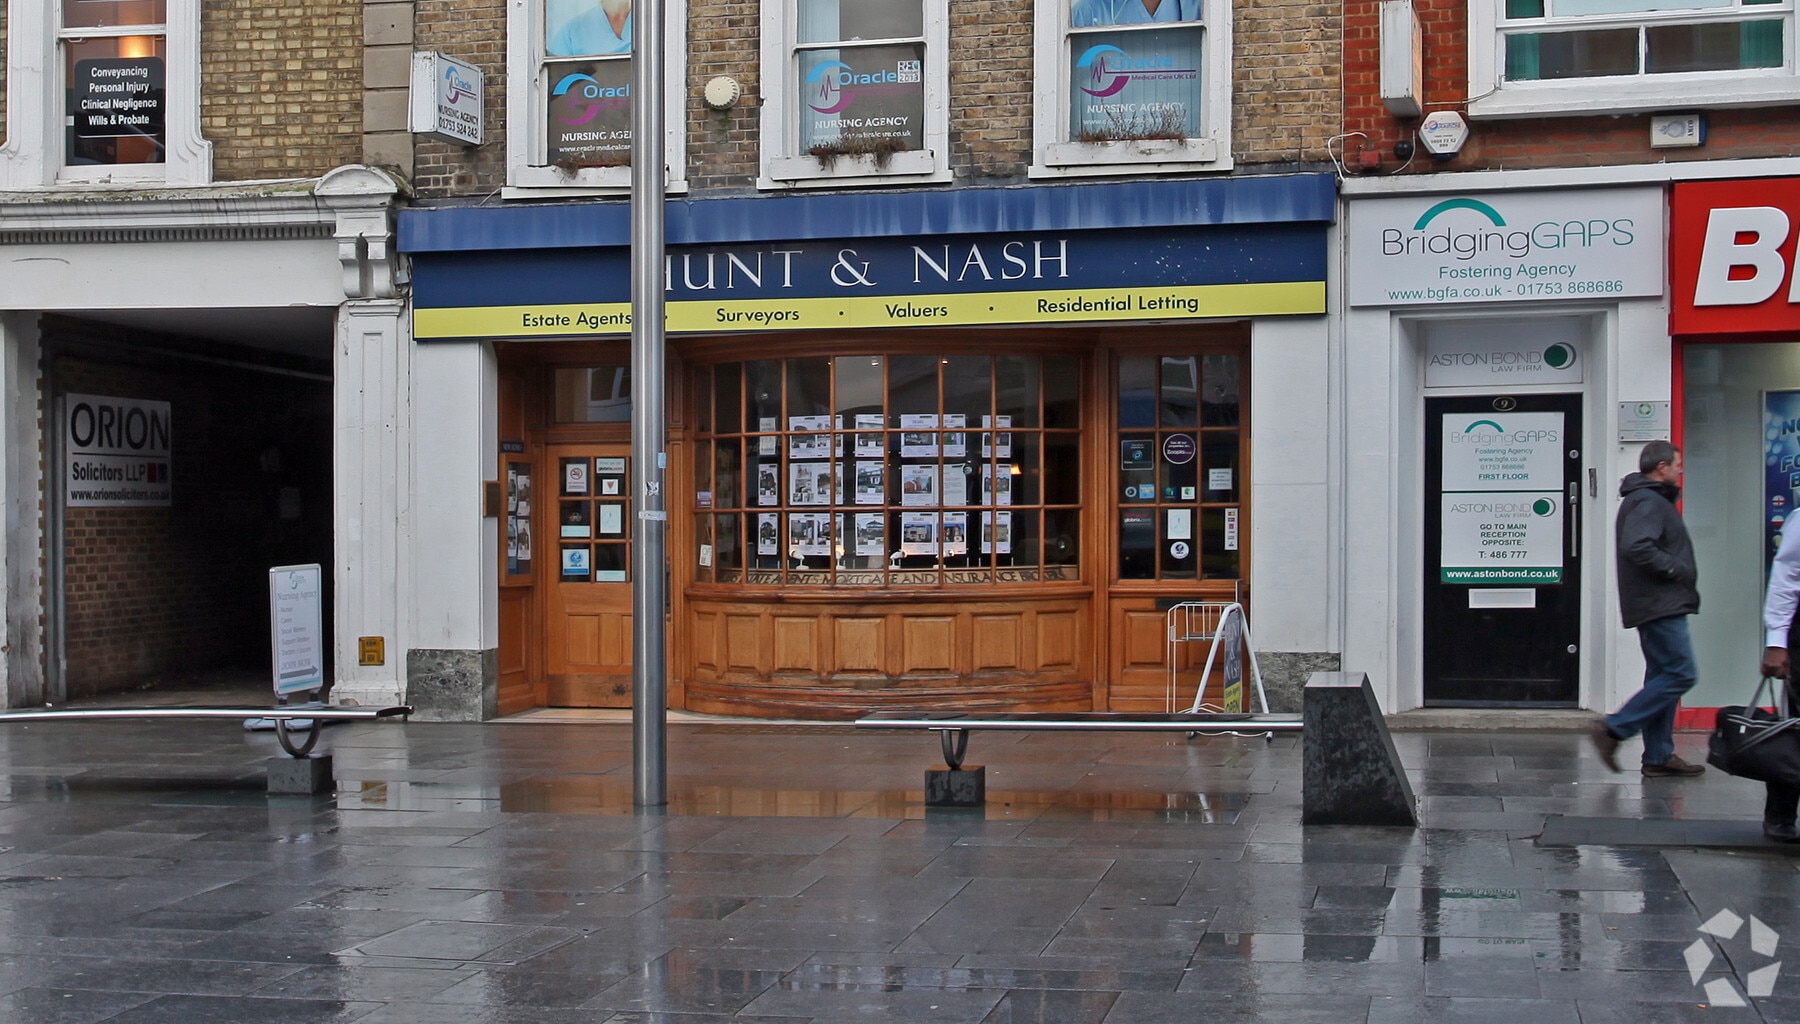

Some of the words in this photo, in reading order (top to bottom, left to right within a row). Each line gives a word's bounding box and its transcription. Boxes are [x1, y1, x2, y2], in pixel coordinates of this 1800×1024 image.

[1110, 55, 1173, 71] Oracle
[91, 66, 148, 78] Conveyancing
[839, 70, 897, 85] Oracle
[89, 82, 124, 92] Personal
[126, 81, 149, 93] Injury
[584, 84, 631, 98] Oracl
[81, 99, 111, 110] Clinical
[112, 98, 157, 110] Negligence
[1087, 103, 1137, 114] NURSING
[1139, 102, 1185, 112] AGENCY
[89, 115, 108, 126] Wills
[110, 115, 116, 125] &
[118, 114, 150, 125] Probate
[438, 104, 459, 120] NURSING
[461, 112, 479, 126] AGENCY
[815, 118, 863, 129] NURSING
[865, 116, 908, 127] AGENCY
[438, 117, 455, 132] 01753
[457, 123, 467, 136] 524
[561, 132, 607, 142] NURSING
[609, 130, 631, 140] AGE
[1382, 219, 1634, 261] BridgingGAPS
[1693, 206, 1800, 307] B
[664, 249, 803, 291] UNT
[830, 248, 877, 287] &
[912, 239, 1069, 283] NASH
[1439, 265, 1512, 279] Fostering
[1516, 263, 1577, 278] Agency
[1388, 284, 1502, 301] www.bgfa.co.uk
[1517, 282, 1562, 296] 01753
[1567, 280, 1623, 294] 868686
[886, 302, 948, 319] Valuers
[1037, 294, 1131, 314] Residential
[1139, 294, 1199, 314] Letting
[522, 312, 570, 327] Estate
[576, 311, 632, 330] Agents
[716, 308, 799, 326] Surveyors
[1430, 352, 1487, 366] ASTON
[1491, 351, 1541, 365] BOND
[1517, 364, 1541, 372] FIRM
[1501, 400, 1508, 408] 9
[71, 403, 169, 450] ORION
[1451, 430, 1557, 446] BridgingGAPS
[72, 462, 122, 481] Solicitors
[126, 464, 145, 481] LLP
[1451, 503, 1492, 513] ASTON
[1495, 503, 1531, 512] BOND
[902, 572, 936, 584] AND
[941, 570, 1017, 584] NSURANCE
[1446, 569, 1558, 578] www.astonbond.co.uk
